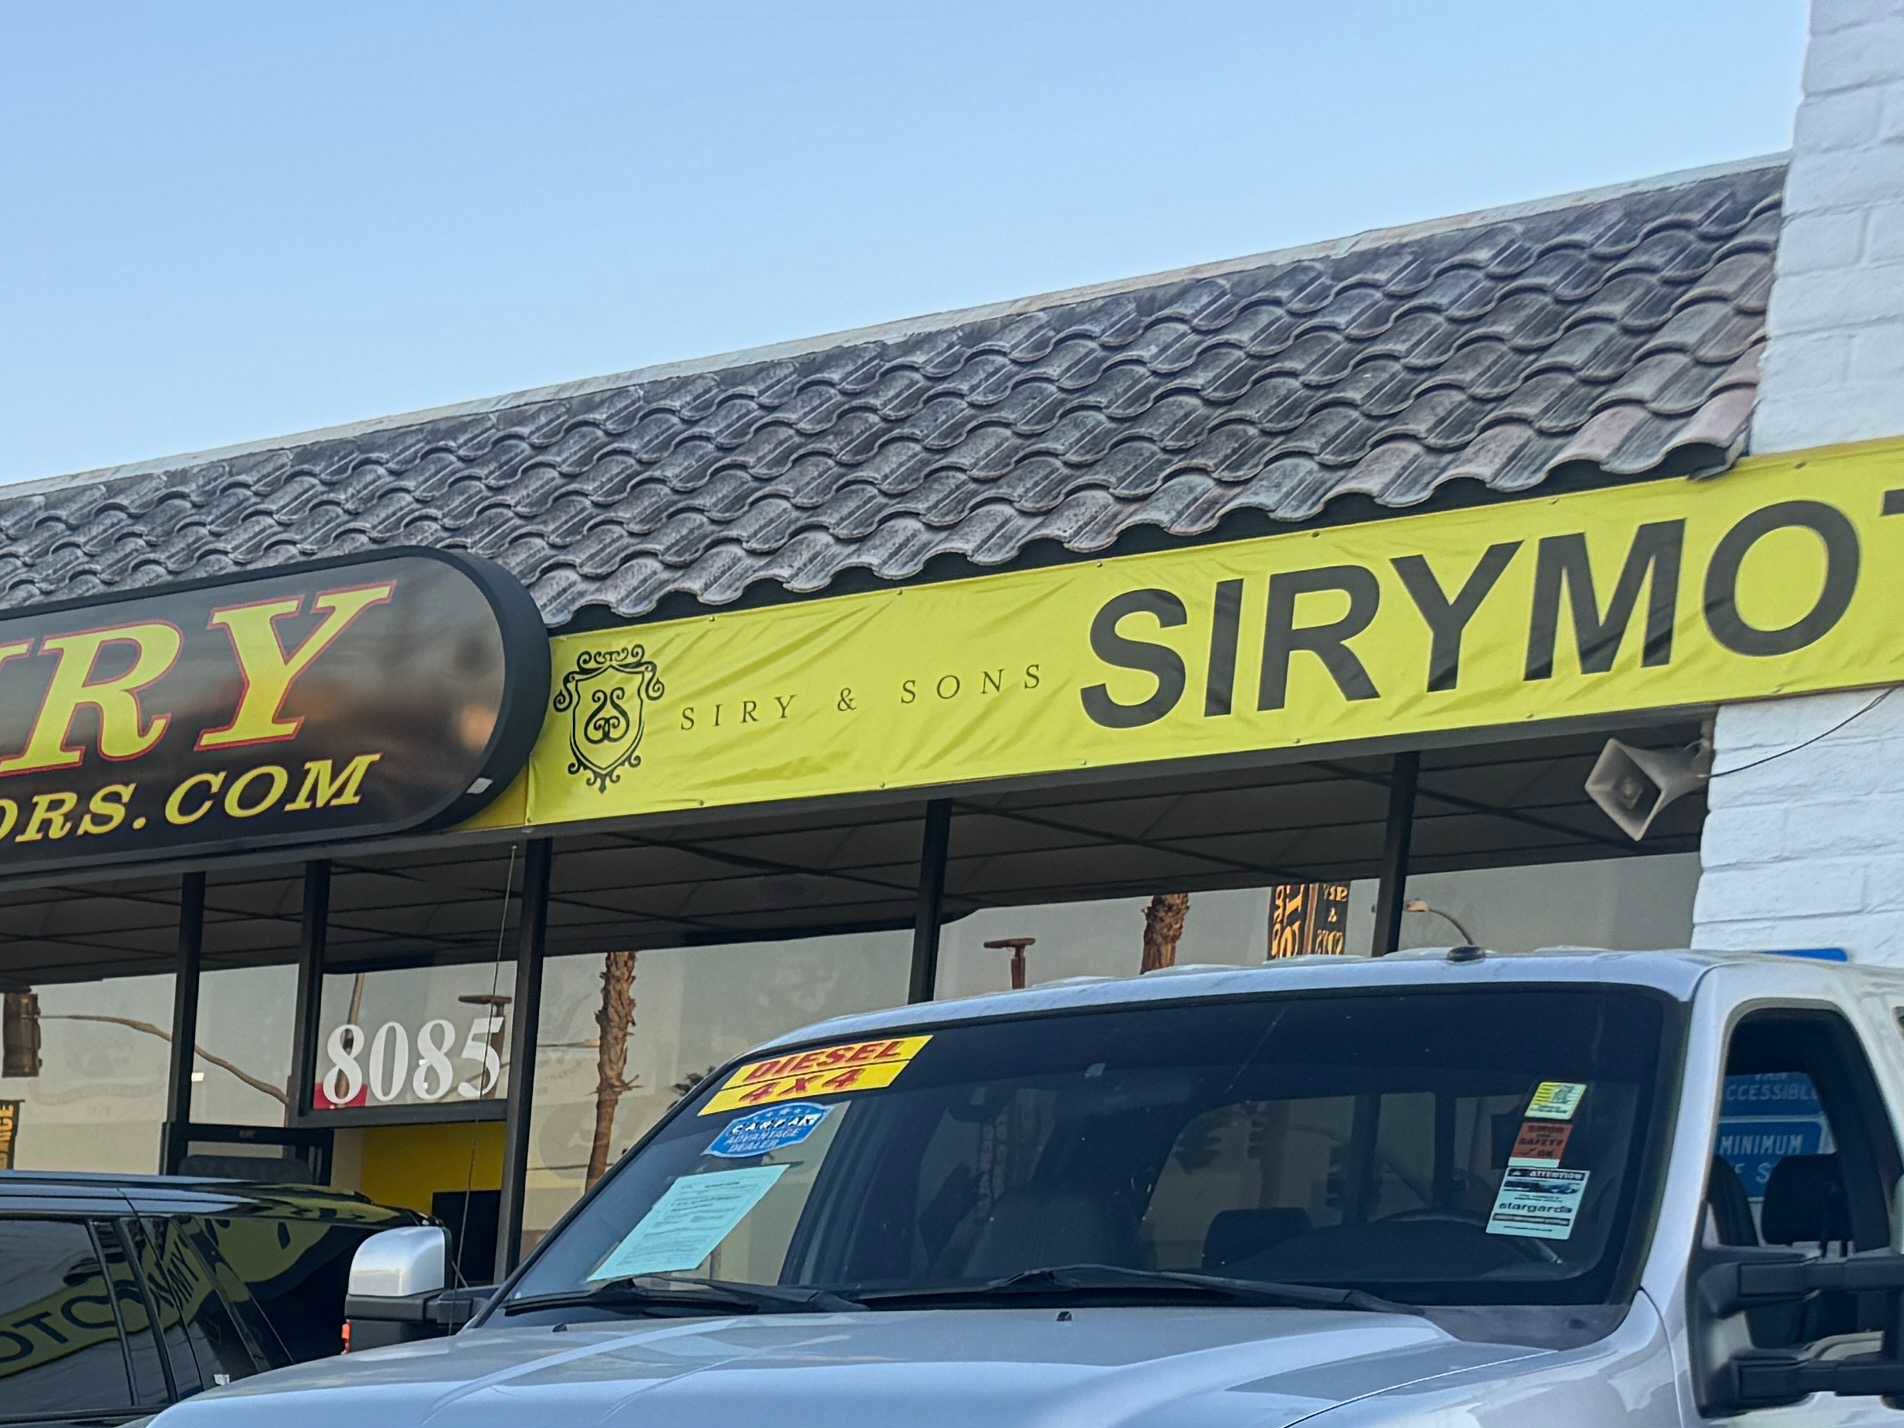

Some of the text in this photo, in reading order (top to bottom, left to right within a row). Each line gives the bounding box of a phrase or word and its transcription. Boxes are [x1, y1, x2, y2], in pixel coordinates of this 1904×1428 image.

[1080, 488, 1903, 729] SIRYMO
[680, 664, 1041, 731] SIRY & SONS
[323, 1017, 504, 1104] 8085
[742, 1040, 905, 1083] DIESEL
[1719, 1133, 1804, 1155] MINIMUM
